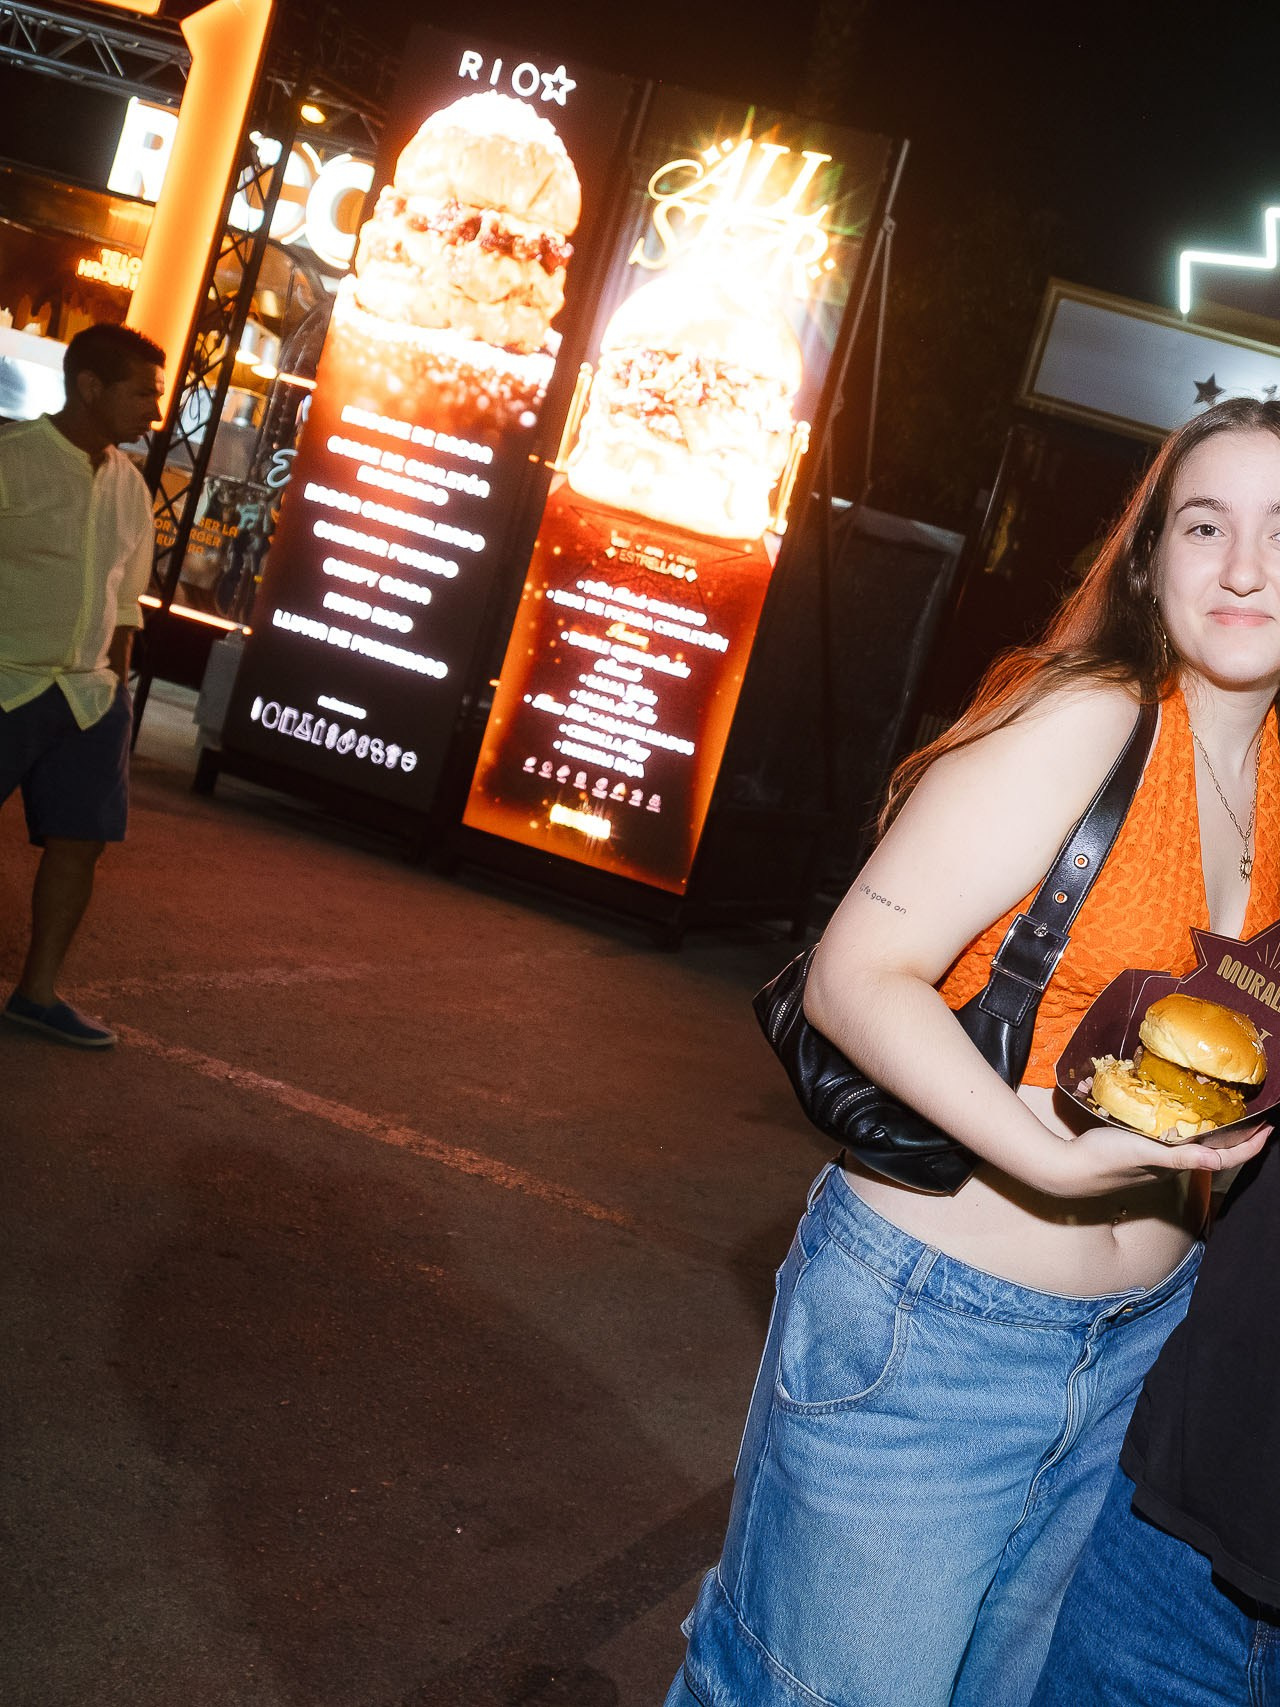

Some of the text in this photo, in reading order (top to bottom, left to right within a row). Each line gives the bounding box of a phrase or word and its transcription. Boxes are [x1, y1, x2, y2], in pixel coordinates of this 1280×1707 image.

[458, 50, 541, 97] RIO
[648, 138, 832, 223] ALL
[628, 200, 830, 298] STR
[870, 892, 892, 907] goes
[894, 905, 907, 914] on
